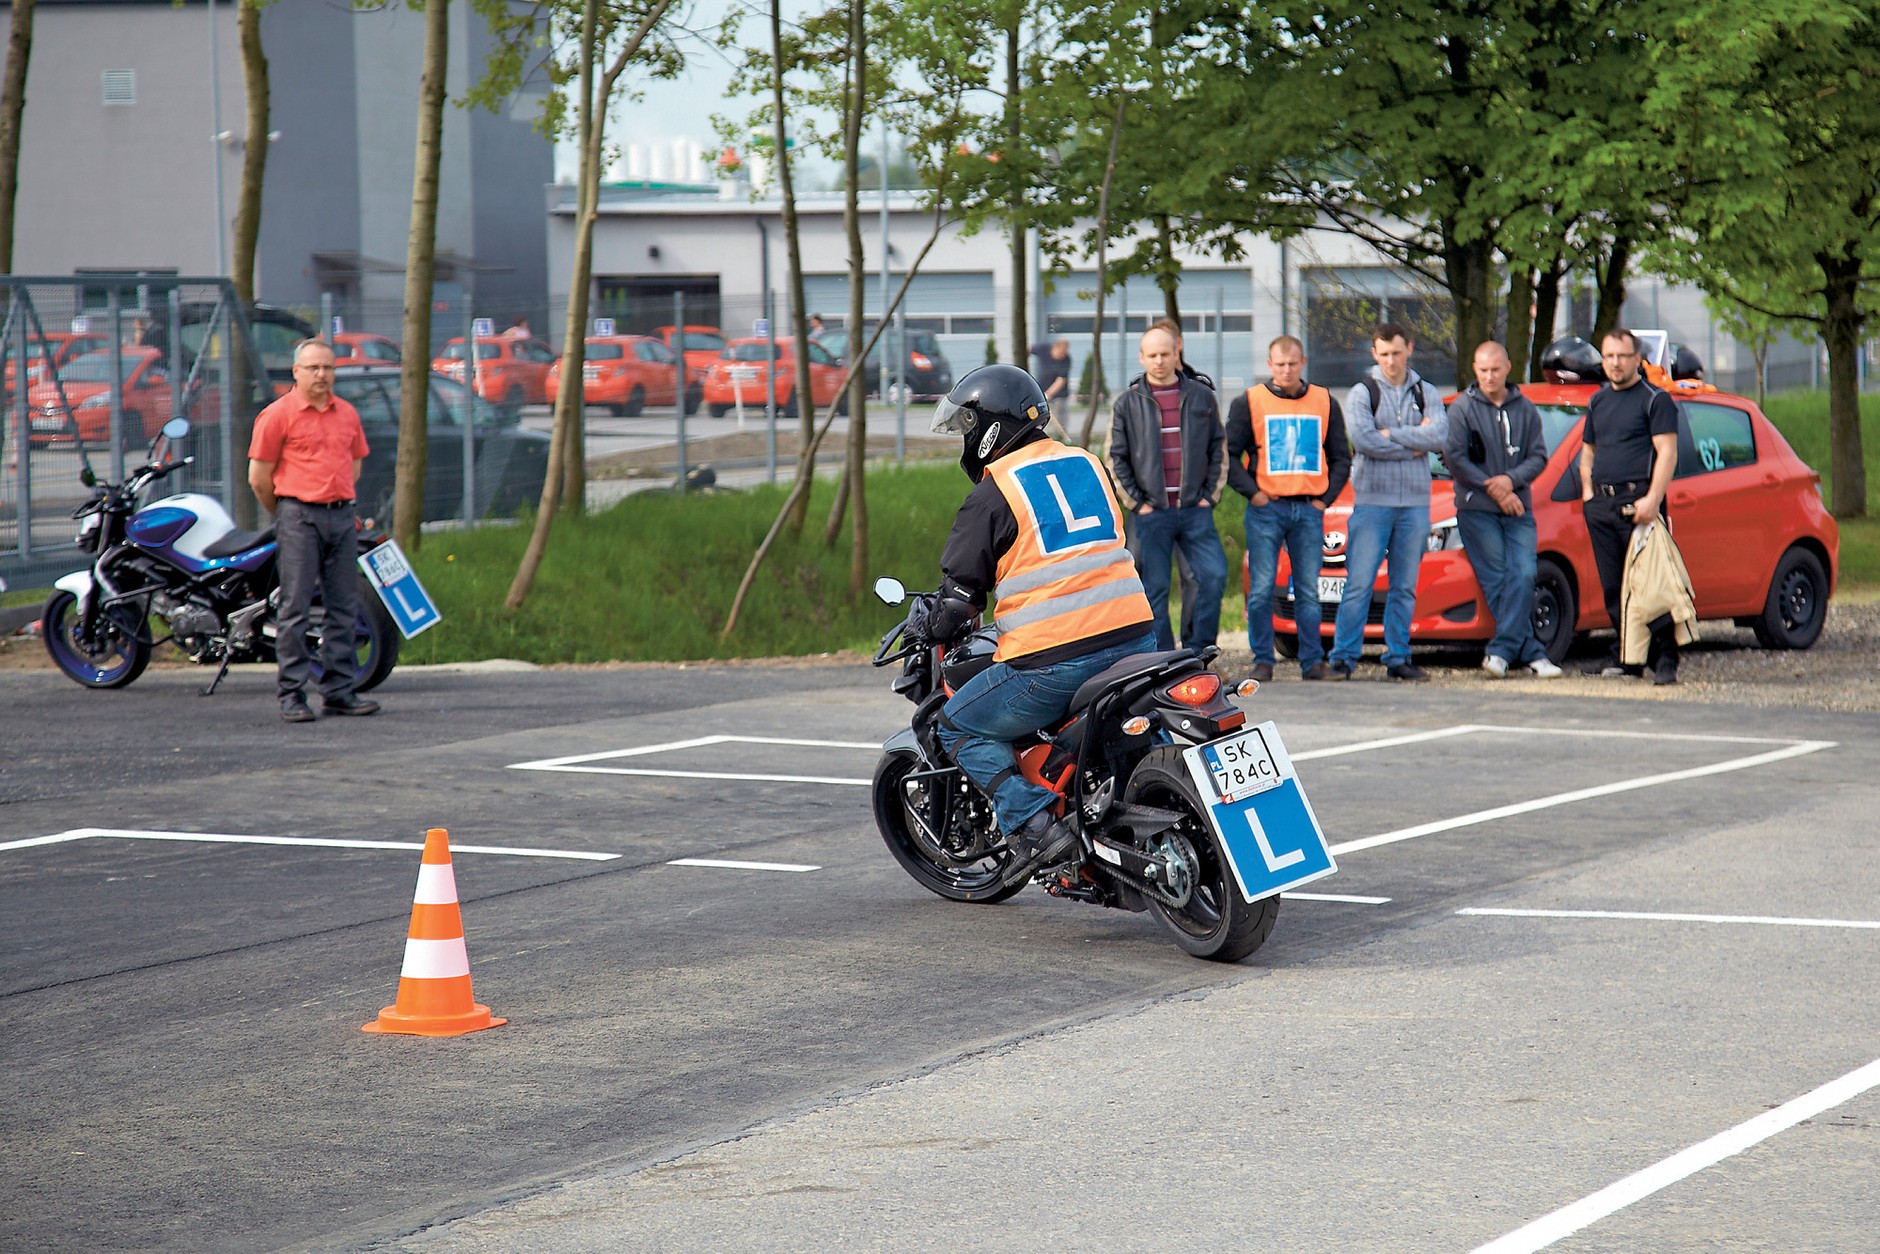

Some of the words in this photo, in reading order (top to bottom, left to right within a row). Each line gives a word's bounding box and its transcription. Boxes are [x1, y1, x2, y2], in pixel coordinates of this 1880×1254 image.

[1699, 437, 1726, 471] 62
[1045, 473, 1102, 533] L
[392, 586, 428, 623] L
[1210, 761, 1223, 771] PL
[1224, 740, 1252, 762] SK
[1219, 759, 1271, 790] 784C
[1243, 807, 1306, 873] L
